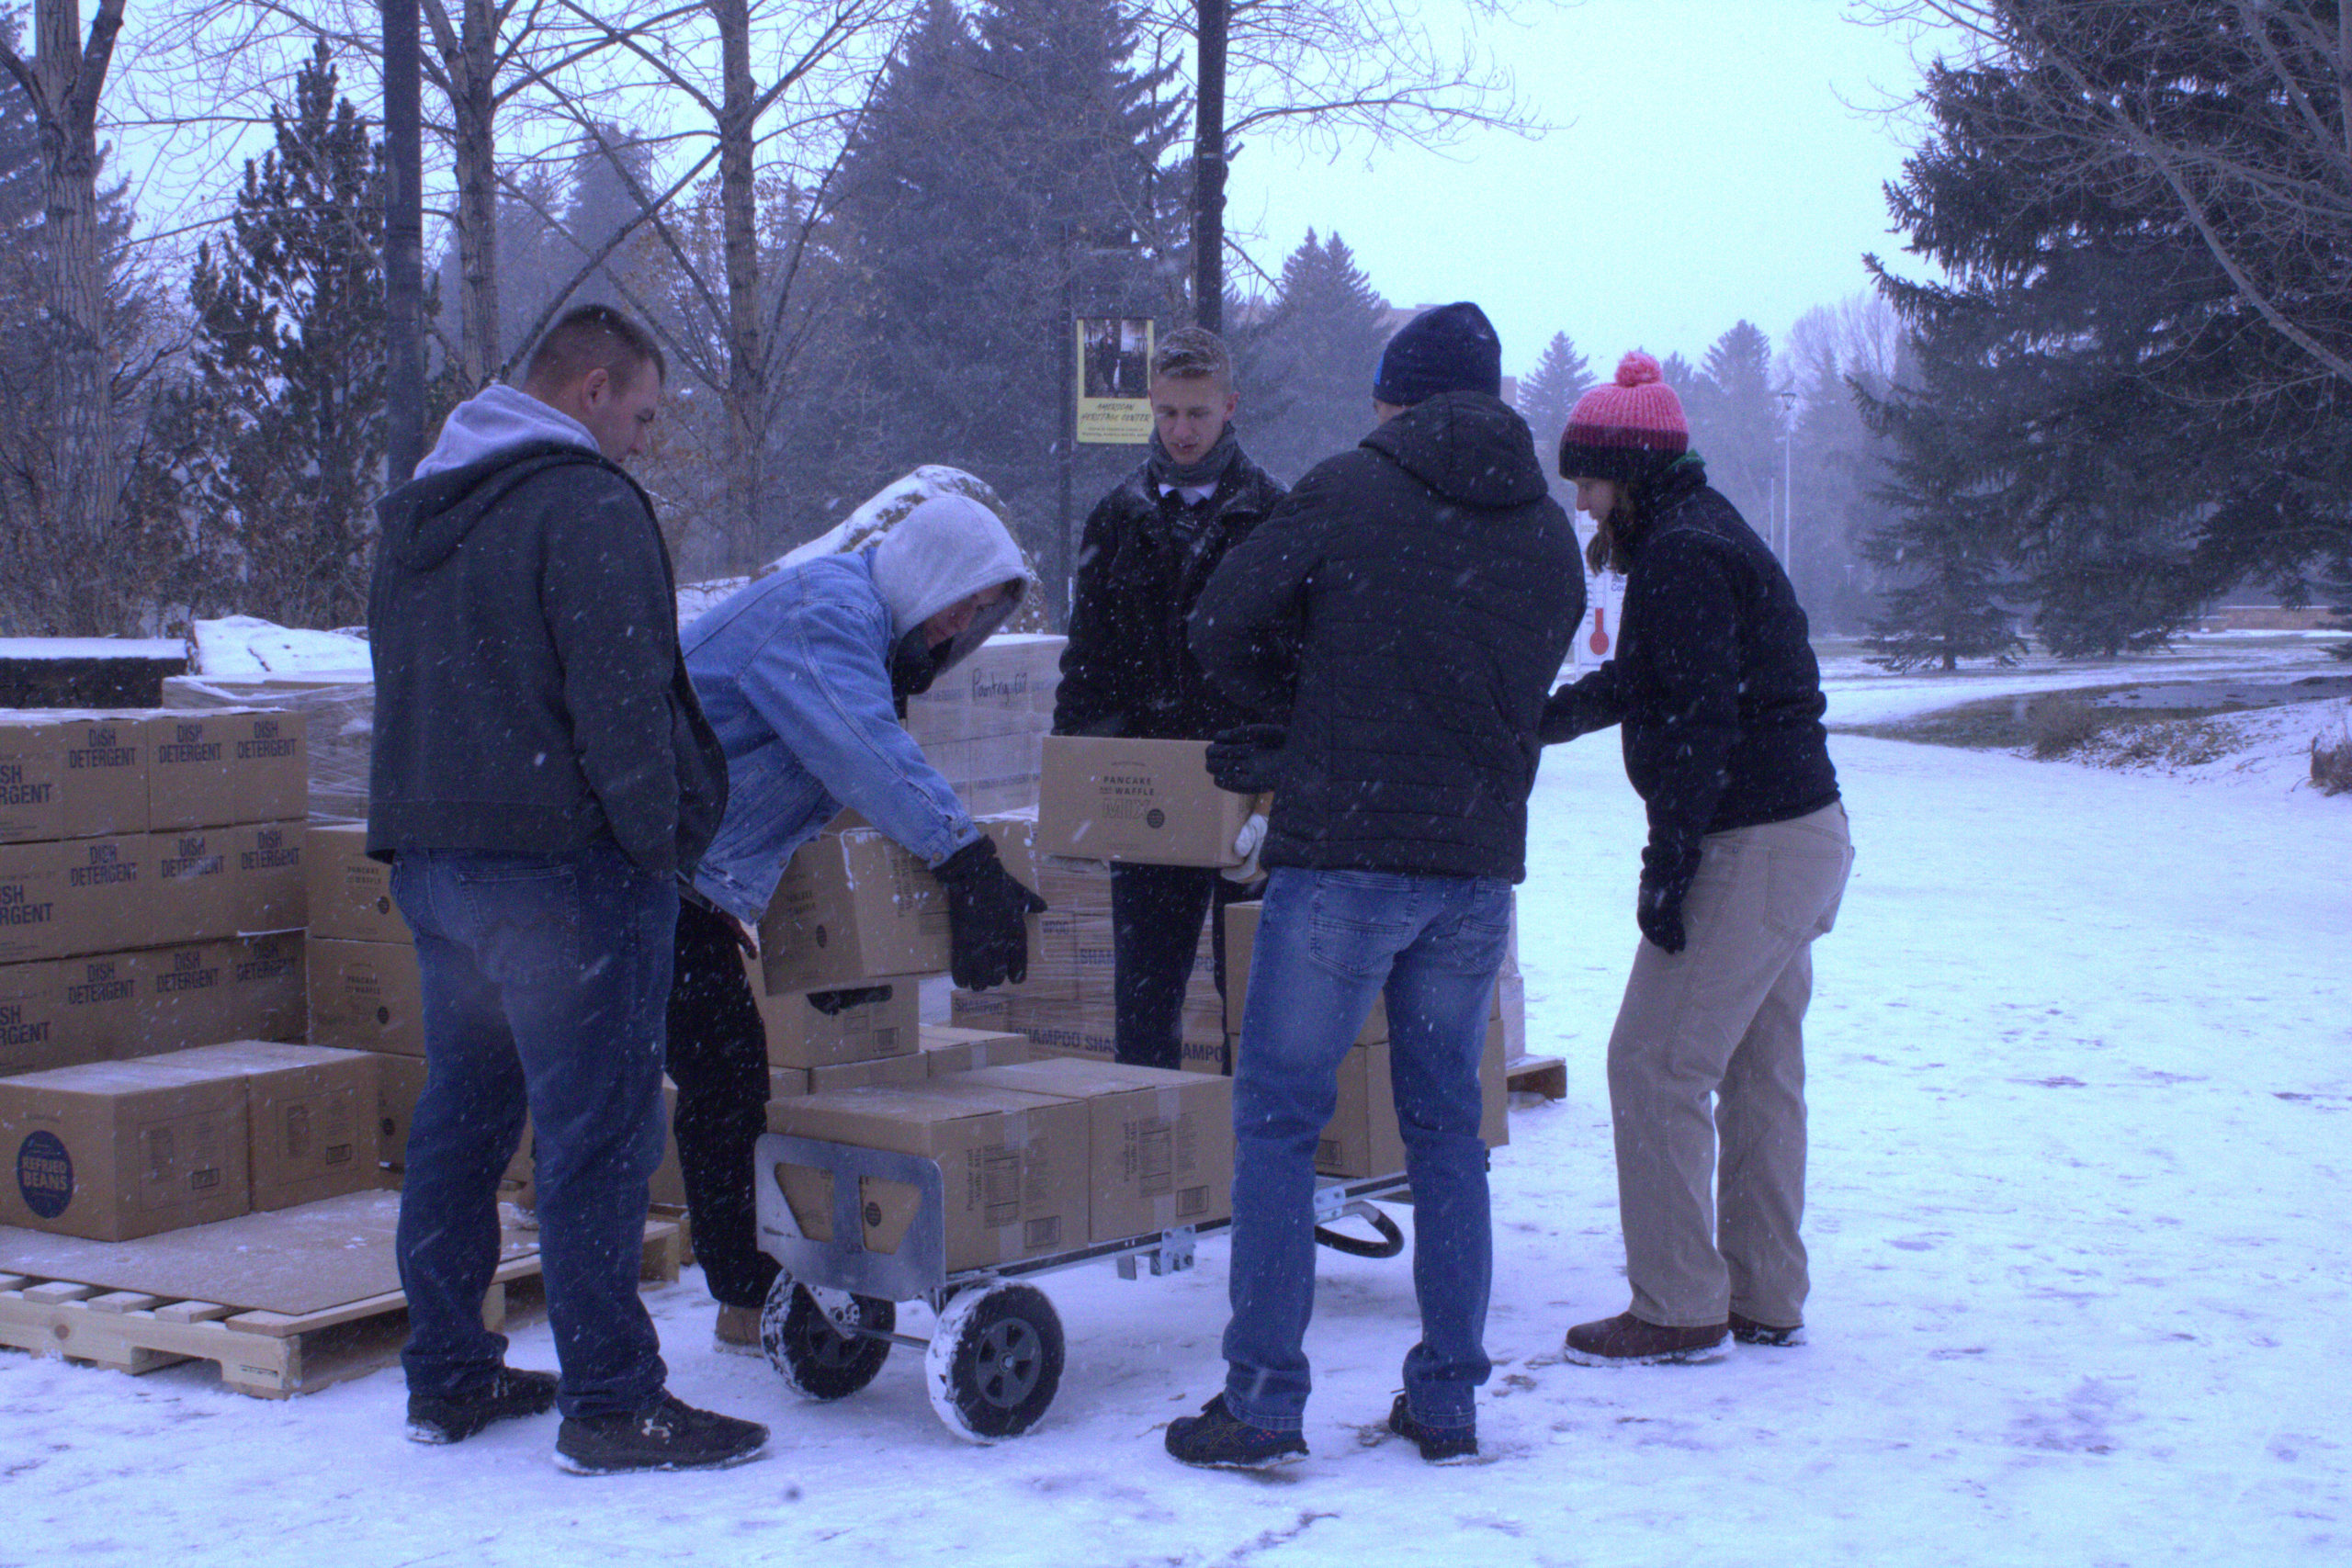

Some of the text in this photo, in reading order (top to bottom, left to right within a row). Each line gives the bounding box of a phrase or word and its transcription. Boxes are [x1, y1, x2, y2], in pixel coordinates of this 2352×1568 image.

[972, 668, 1010, 707] Pantry
[89, 728, 116, 747] DISH
[177, 724, 202, 742] DISH
[254, 720, 278, 739] DISH
[69, 748, 136, 769] DETERGENT
[159, 742, 221, 763] DETERGENT
[237, 738, 297, 759] DETERGENT
[1103, 775, 1151, 785] PANCAKE
[1114, 787, 1155, 795] WAFFLE
[1102, 797, 1151, 819] MIX
[179, 837, 205, 857] DISH
[258, 830, 283, 849] DISH
[90, 845, 118, 864] DISH
[242, 848, 300, 870] DETERGENT
[71, 862, 138, 887] DETERGENT
[162, 856, 225, 878] DETERGENT
[174, 952, 200, 972] DISH
[236, 958, 297, 983] DETERGENT
[87, 962, 115, 983] DISH
[157, 967, 219, 993] DETERGENT
[68, 979, 135, 1005] DETERGENT
[956, 998, 1003, 1015] SHAMPOO
[22, 1156, 67, 1174] REFRIED
[23, 1170, 69, 1190] BEANS
